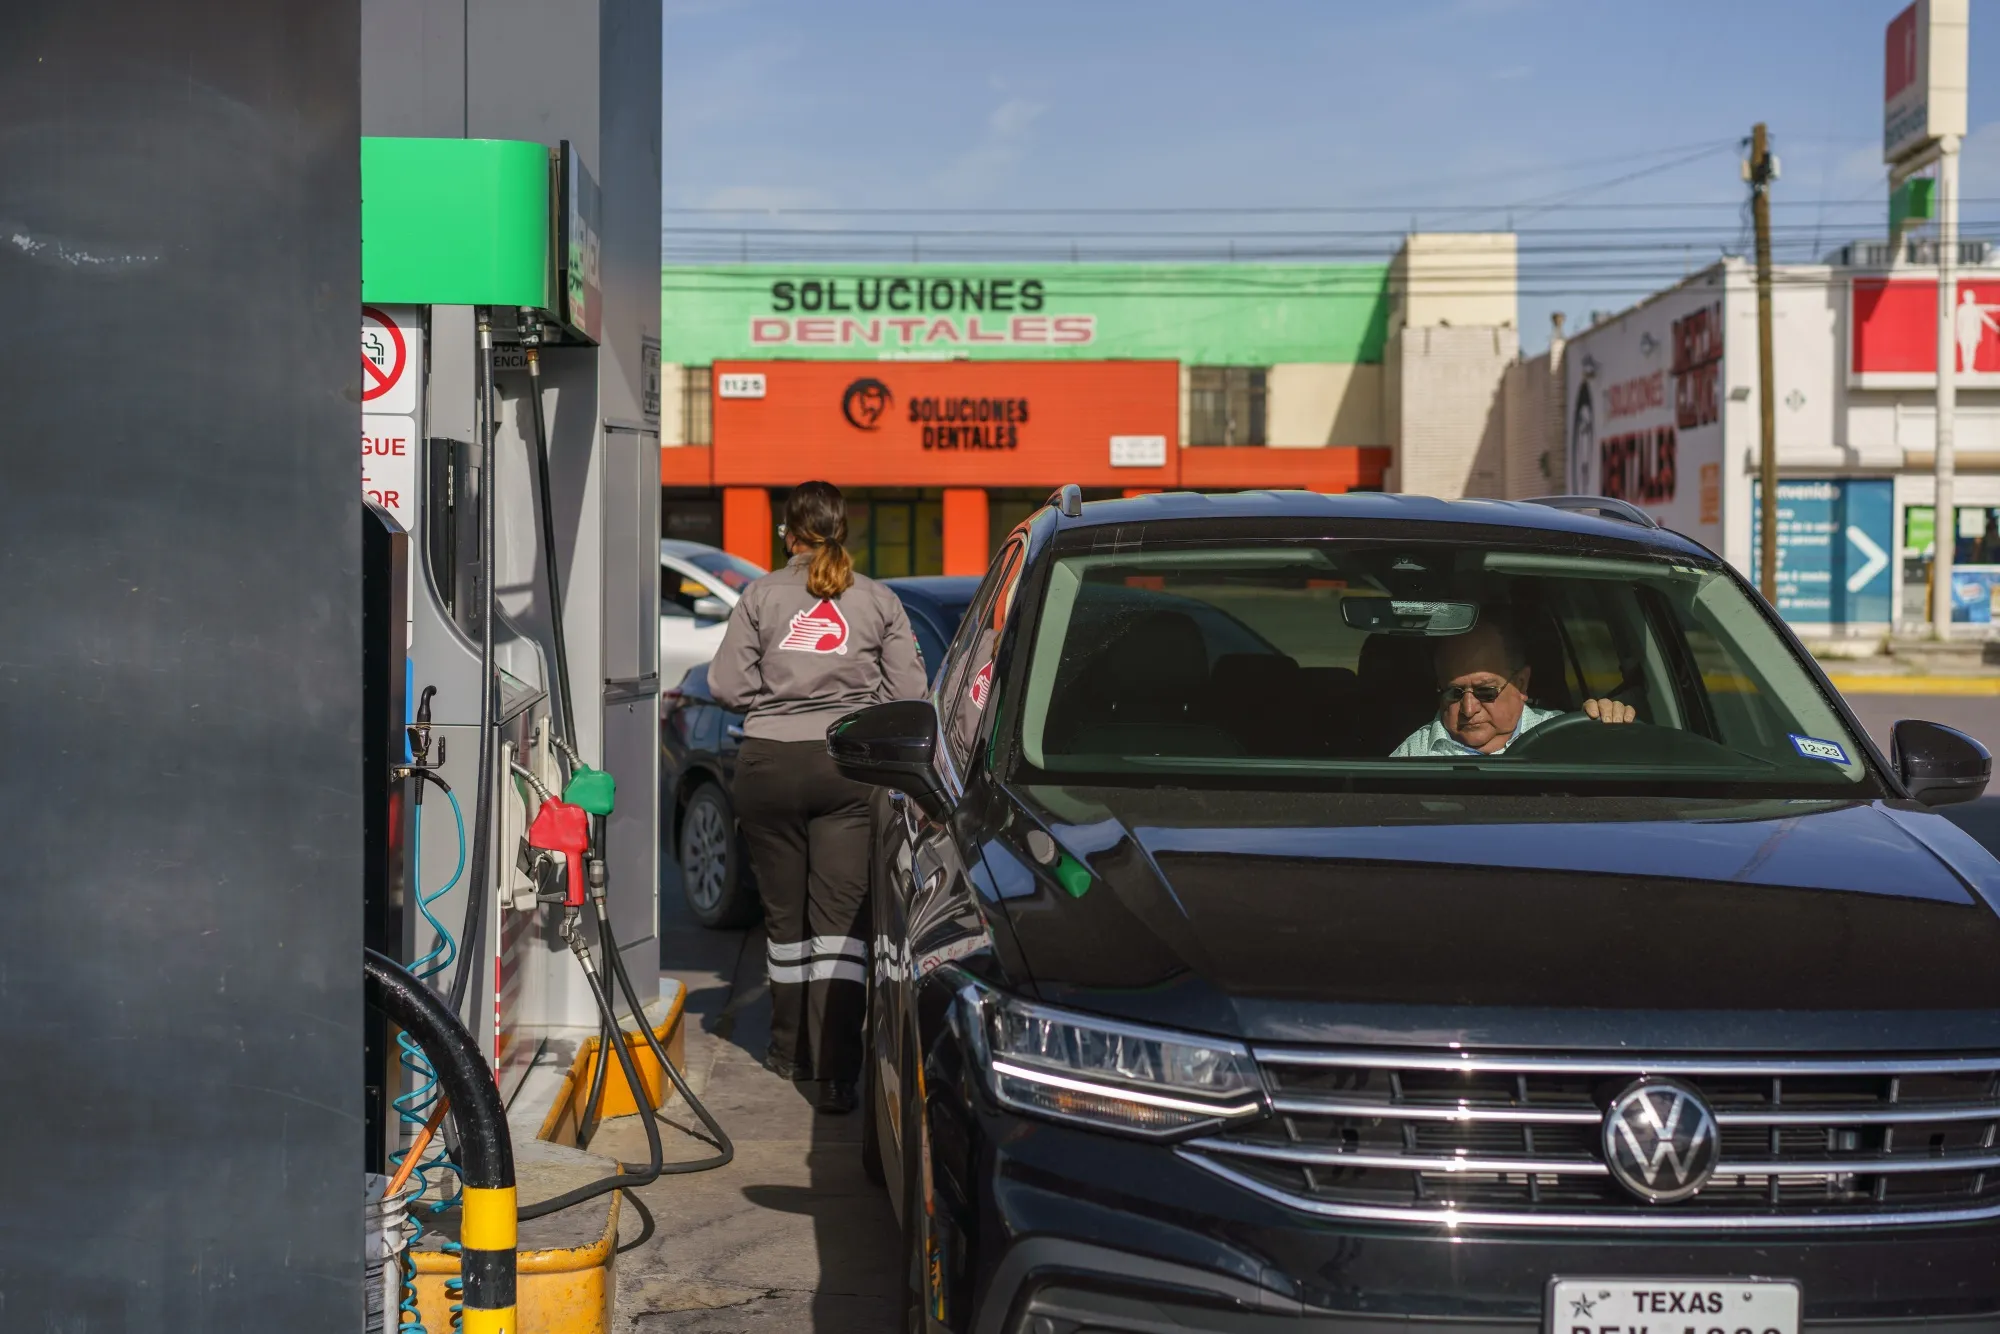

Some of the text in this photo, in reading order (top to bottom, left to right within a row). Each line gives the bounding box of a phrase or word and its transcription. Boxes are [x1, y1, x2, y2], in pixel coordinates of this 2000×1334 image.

[772, 279, 1045, 312] SOLUCIONES
[751, 316, 1095, 345] DENTALES
[908, 397, 1028, 423] SOLUCIONES
[922, 426, 1018, 449] DENTALES
[1801, 743, 1840, 757] 12-23
[1633, 1291, 1723, 1313] TEXAS
